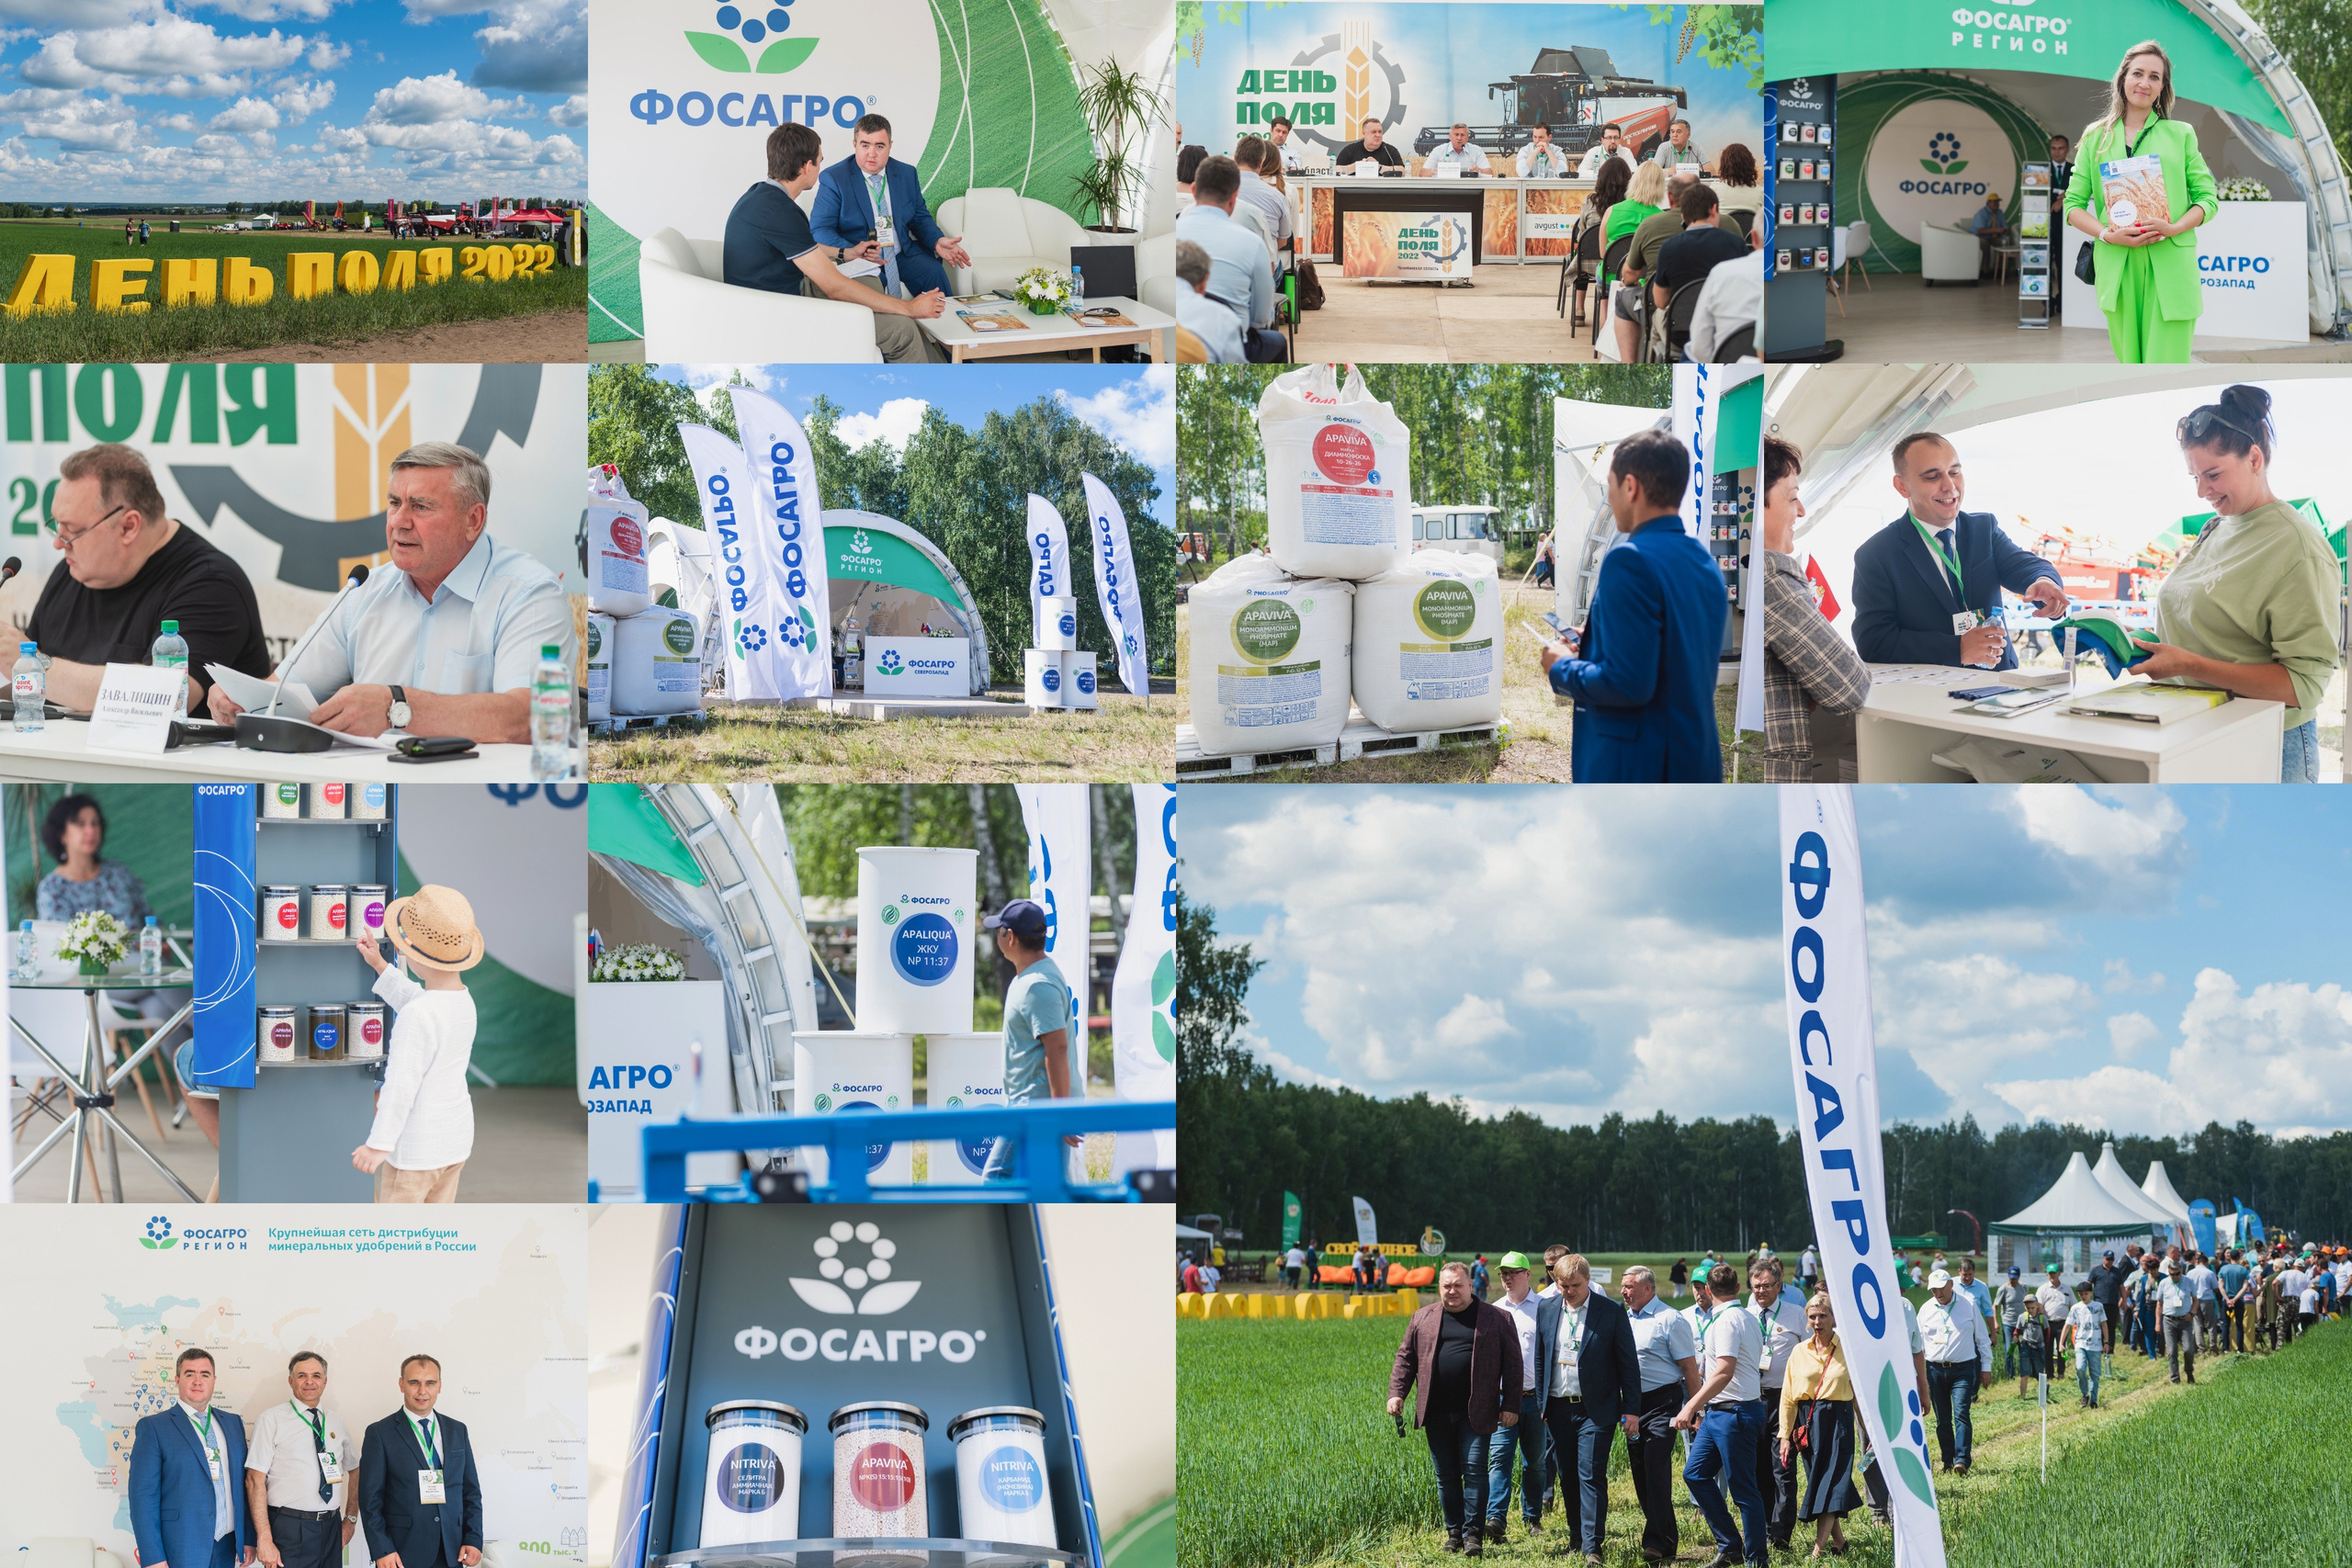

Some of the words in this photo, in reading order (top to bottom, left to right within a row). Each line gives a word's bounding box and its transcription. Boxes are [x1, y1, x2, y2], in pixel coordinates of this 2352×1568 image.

[1952, 8, 2067, 35] ФОСАГРО
[1952, 31, 2067, 55] РЕГИОН
[1237, 70, 1337, 95] ДЕНЬ
[629, 89, 865, 129] ФОСАГРО
[1780, 99, 1822, 110] ФОСАГРО
[1237, 102, 1336, 125] ПОЛЯ
[1899, 180, 1986, 196] ФОСАГРО
[1534, 221, 1558, 231] avgust
[1397, 228, 1439, 239] ДЕНЬ
[1397, 241, 1439, 251] ПОЛЯ
[2198, 255, 2269, 273] САГРО
[0, 254, 274, 321] ДЕНЬ
[287, 247, 453, 300] ПОЛЯ
[459, 243, 555, 283] 2022
[2200, 278, 2255, 289] РОЗАПАД
[5, 364, 299, 446] ПОЛЯ
[1325, 434, 1367, 446] APAVIVA
[1325, 451, 1371, 460] ДИАММОФОСКА
[770, 442, 806, 599] ФОСАГРО
[841, 554, 882, 566] ФОСАГРО
[841, 564, 882, 574] РЕГИОН
[1427, 592, 1468, 601] APAVIVA
[1244, 611, 1292, 622] APAVIVA
[1239, 625, 1297, 633] MONOAMMONIUM
[908, 660, 955, 669] ФОСАГРО
[100, 689, 172, 706] ЗАВАЛИЩИН
[101, 705, 130, 716] Александр
[130, 707, 164, 717] Васильевич
[198, 785, 245, 795] ФОСАГРО
[911, 897, 950, 905] ФОСАГРО
[902, 930, 951, 942] APALIQUA
[917, 944, 939, 953] ЖКУ
[908, 956, 921, 965] NP
[924, 957, 949, 965] 11:37
[588, 1064, 673, 1089] АГРО
[1790, 830, 1886, 1339] ФОСАГРО
[982, 1135, 997, 1144] ЖК
[865, 1145, 883, 1154] 1:37
[184, 1228, 247, 1239] ФОСАГРО
[268, 1227, 346, 1240] Крупнейшая
[349, 1229, 375, 1239] сеть
[378, 1227, 458, 1241] дистрибуции
[184, 1241, 247, 1250] РЕГИОН
[268, 1241, 353, 1252] минеральных
[356, 1240, 422, 1253] удобрений
[435, 1241, 477, 1251] России
[734, 1325, 978, 1363] ФОСАГРО
[730, 1459, 775, 1470] NITRIVA
[862, 1458, 908, 1470] APAVIVA
[991, 1461, 1035, 1472] NITRIVA
